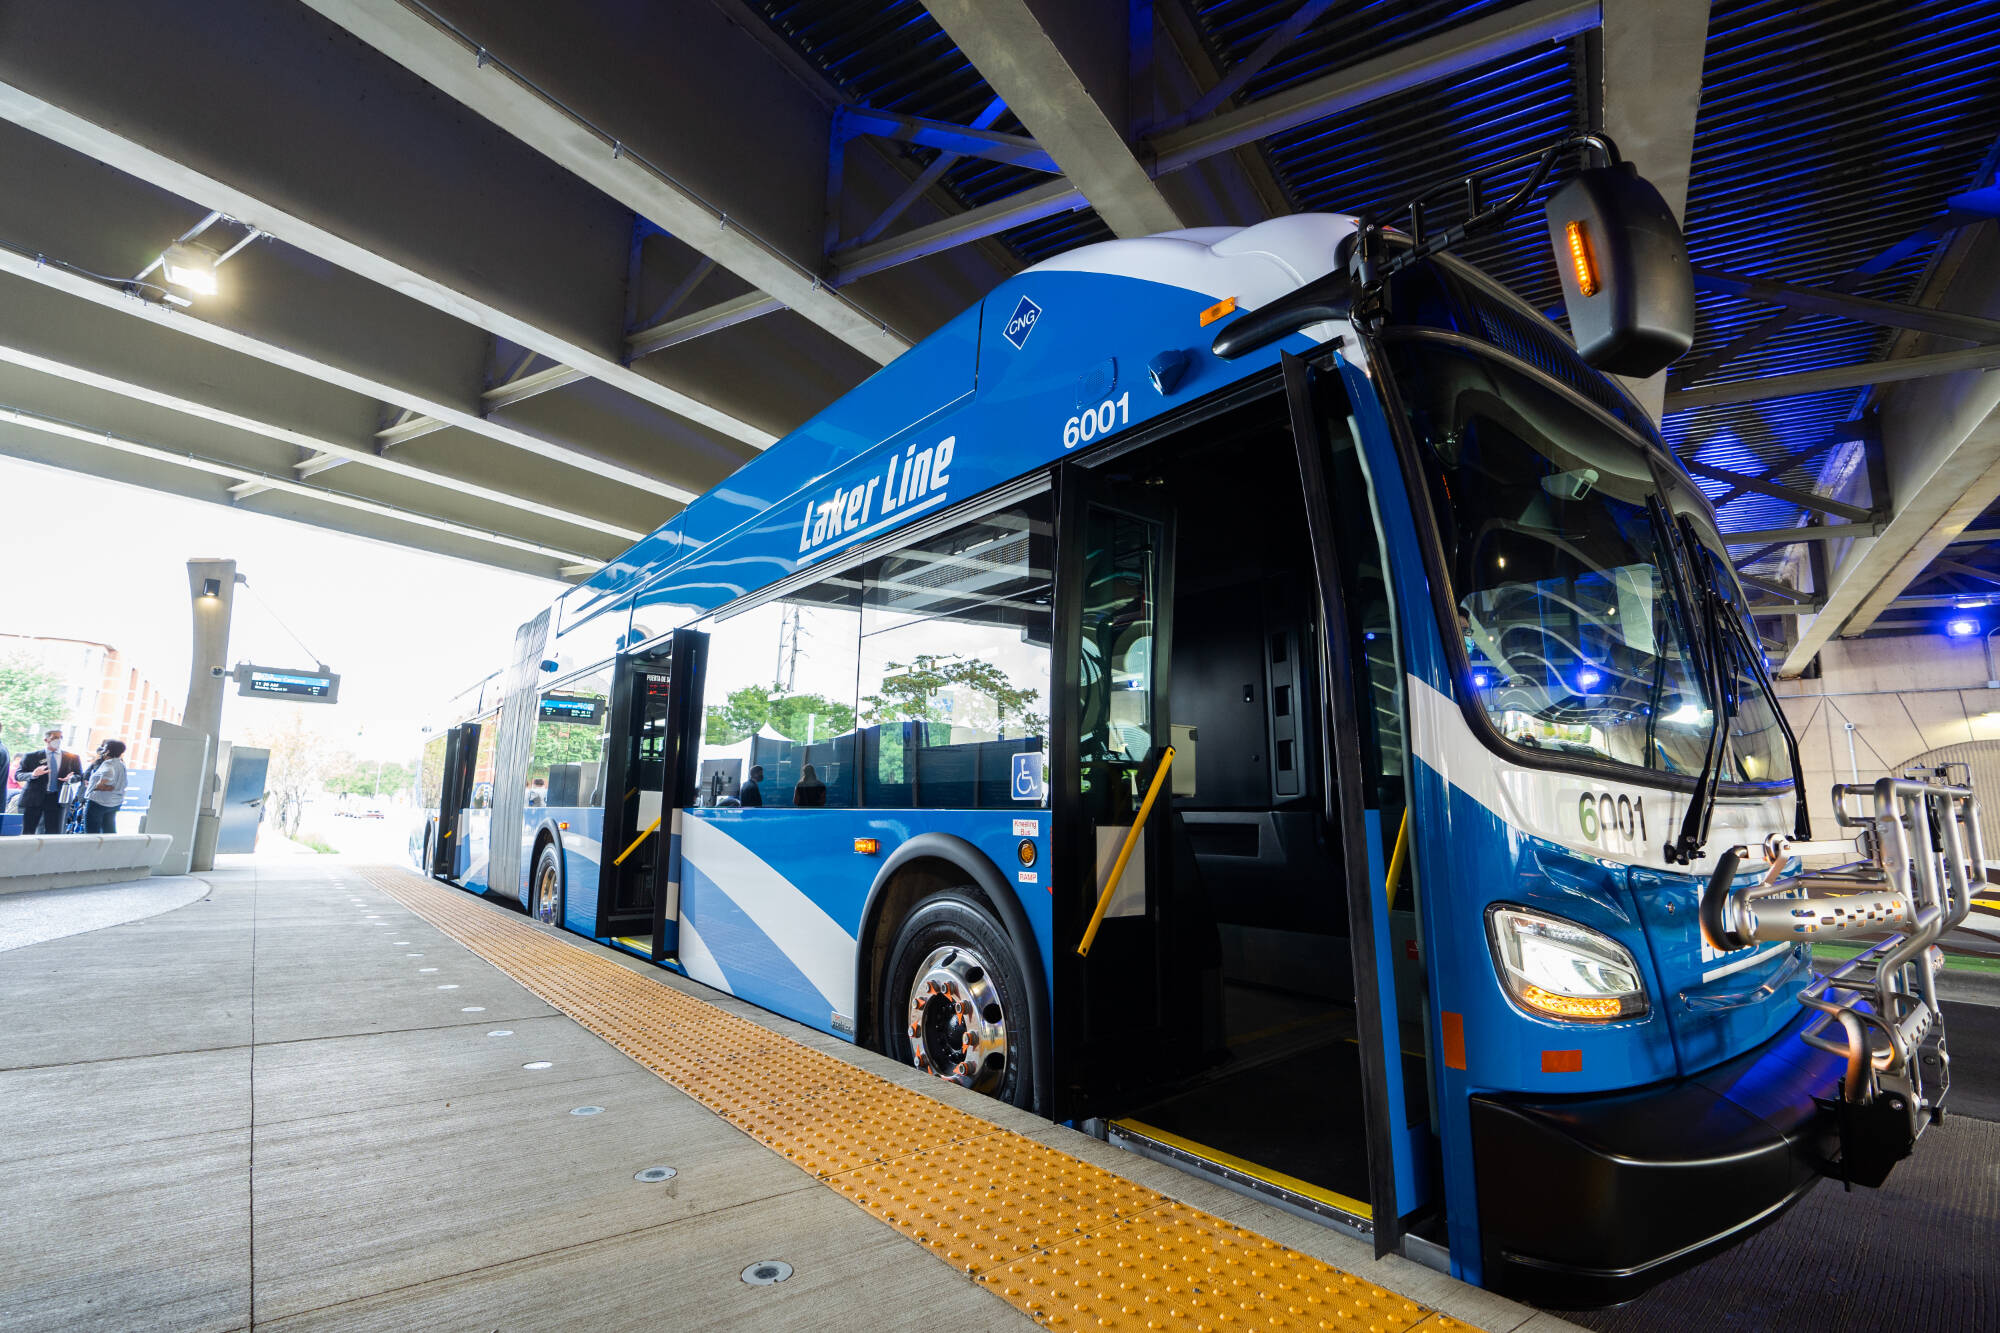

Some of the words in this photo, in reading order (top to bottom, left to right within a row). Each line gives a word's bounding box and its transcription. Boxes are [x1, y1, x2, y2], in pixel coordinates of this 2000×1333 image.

[1009, 310, 1035, 335] CNG
[1063, 391, 1129, 449] 6001
[799, 475, 880, 553] Laker
[881, 435, 956, 515] Line
[1014, 820, 1036, 830] Kneeling
[1579, 791, 1647, 842] 6001
[1020, 874, 1036, 882] RAMP
